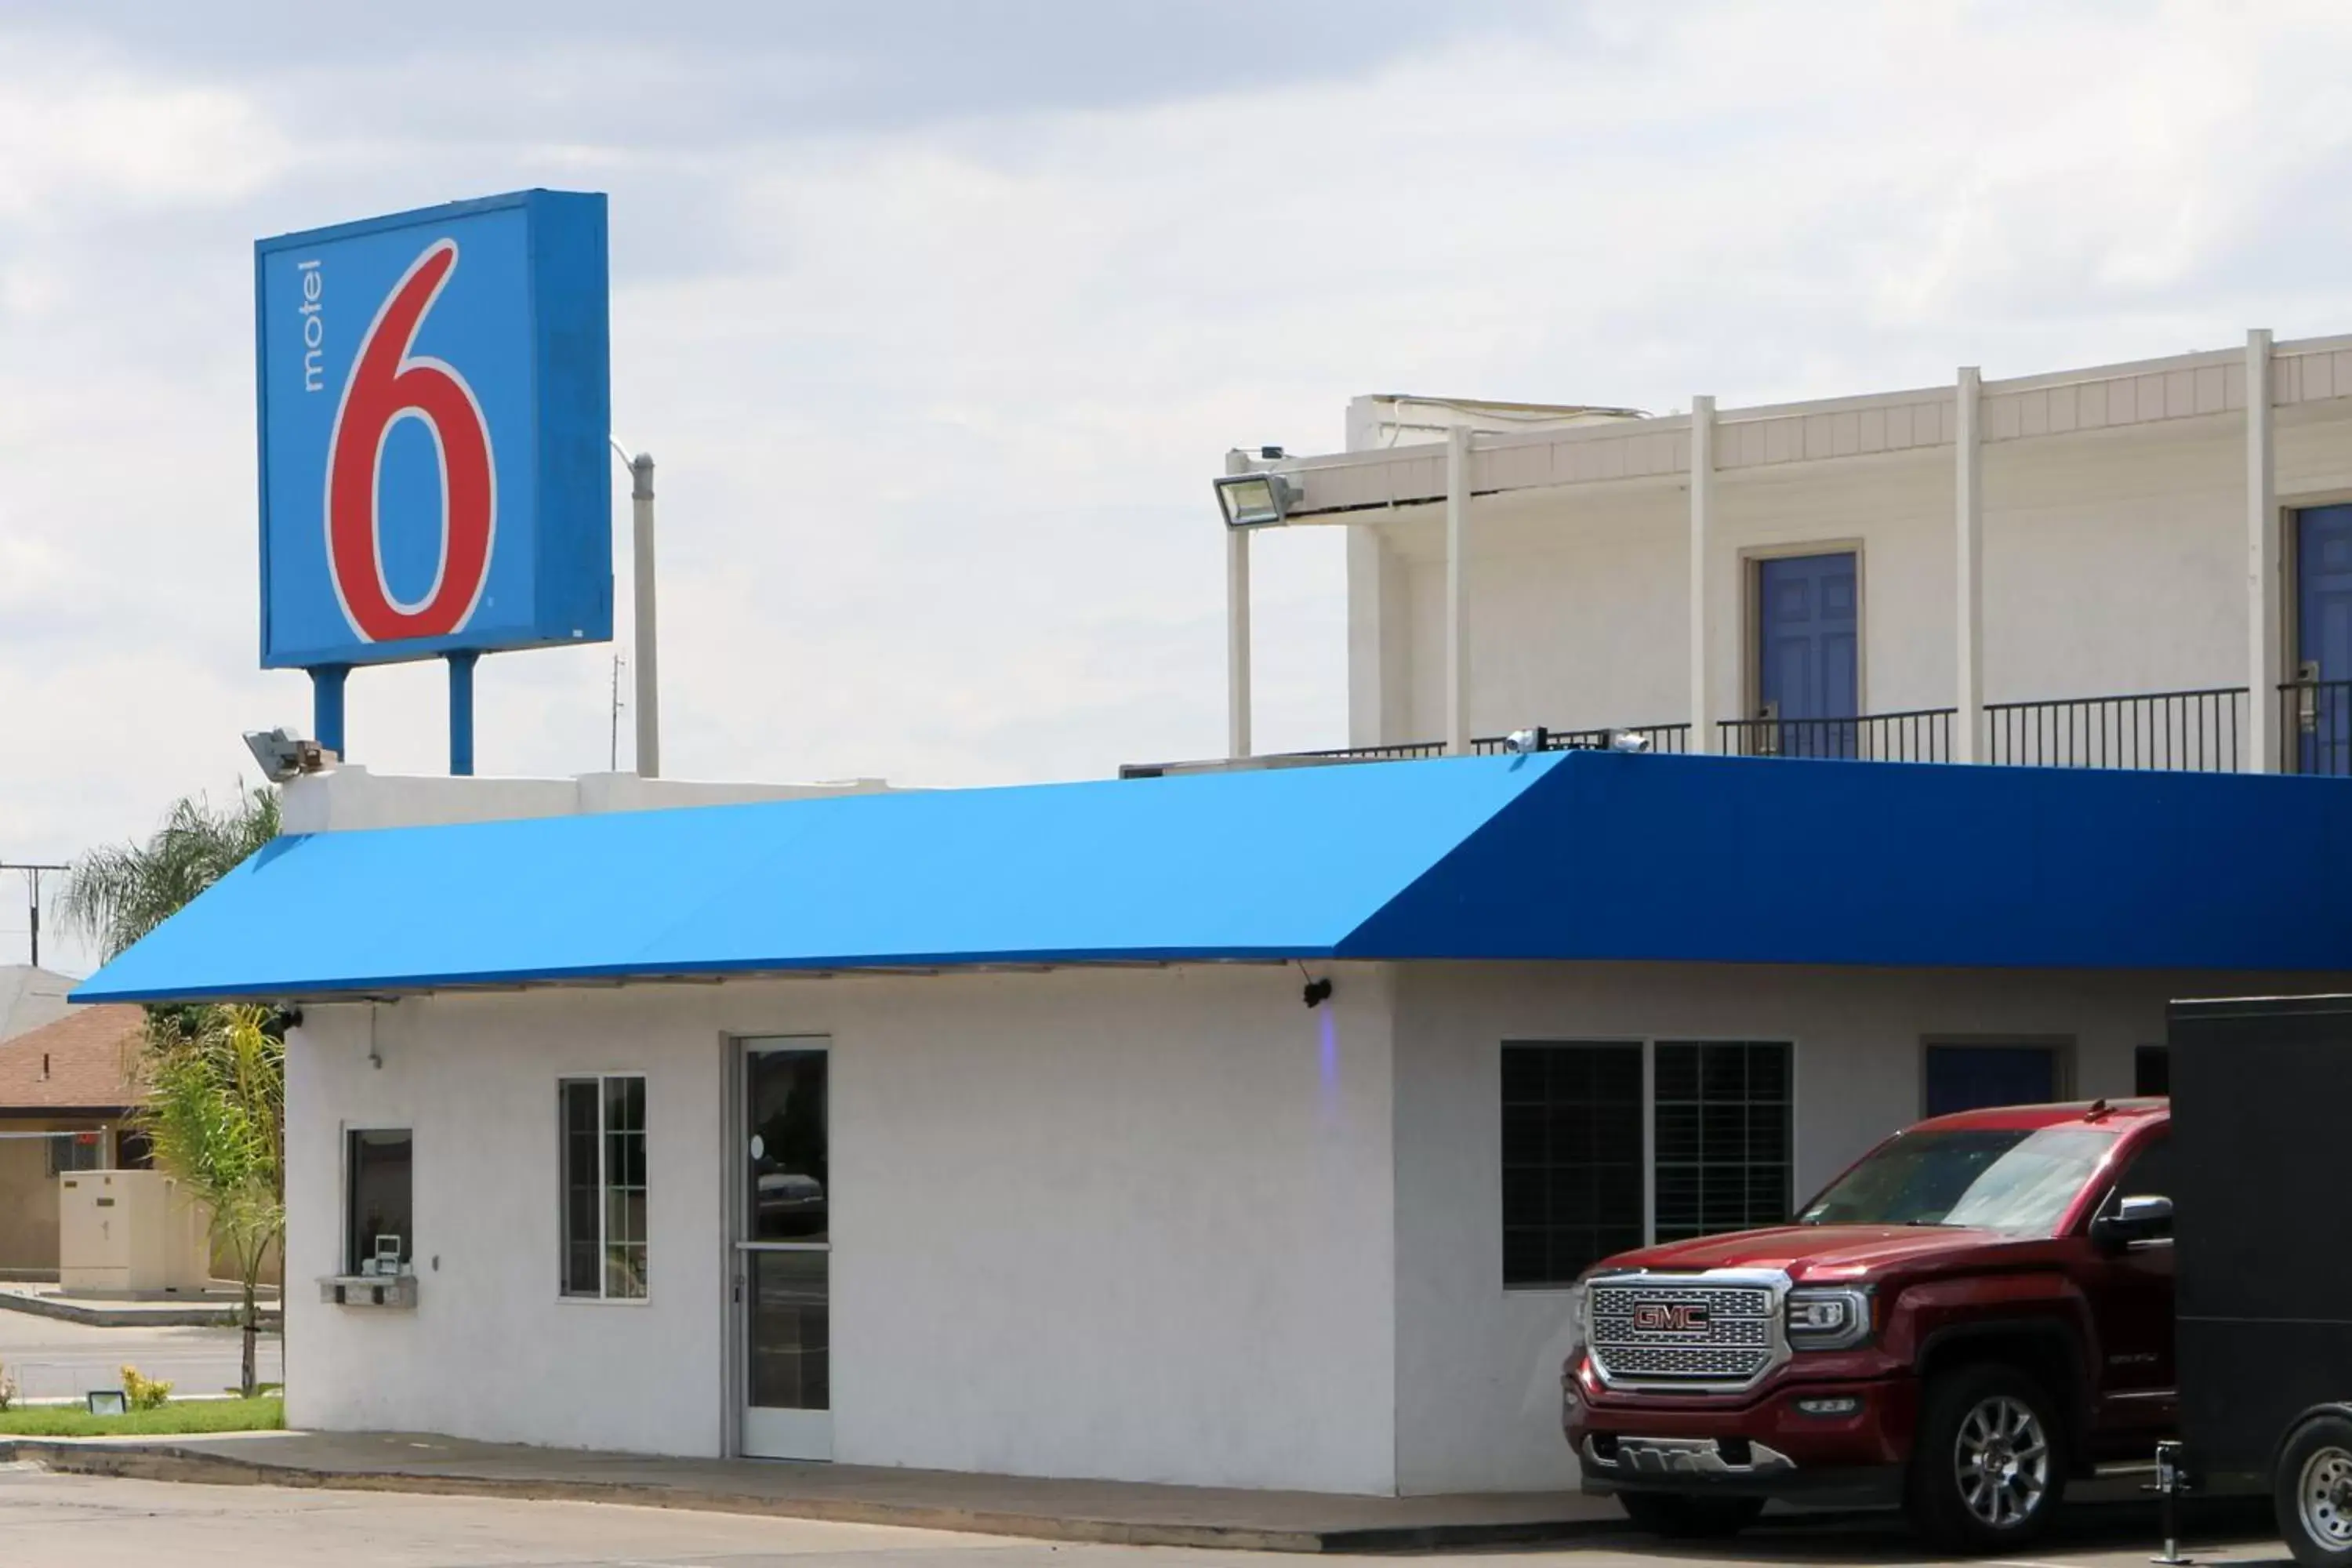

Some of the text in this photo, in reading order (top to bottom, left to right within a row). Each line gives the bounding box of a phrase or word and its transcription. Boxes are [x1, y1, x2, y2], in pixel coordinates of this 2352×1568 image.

[297, 260, 324, 391] motel
[324, 238, 497, 644] 6
[1634, 1304, 1708, 1329] GMC
